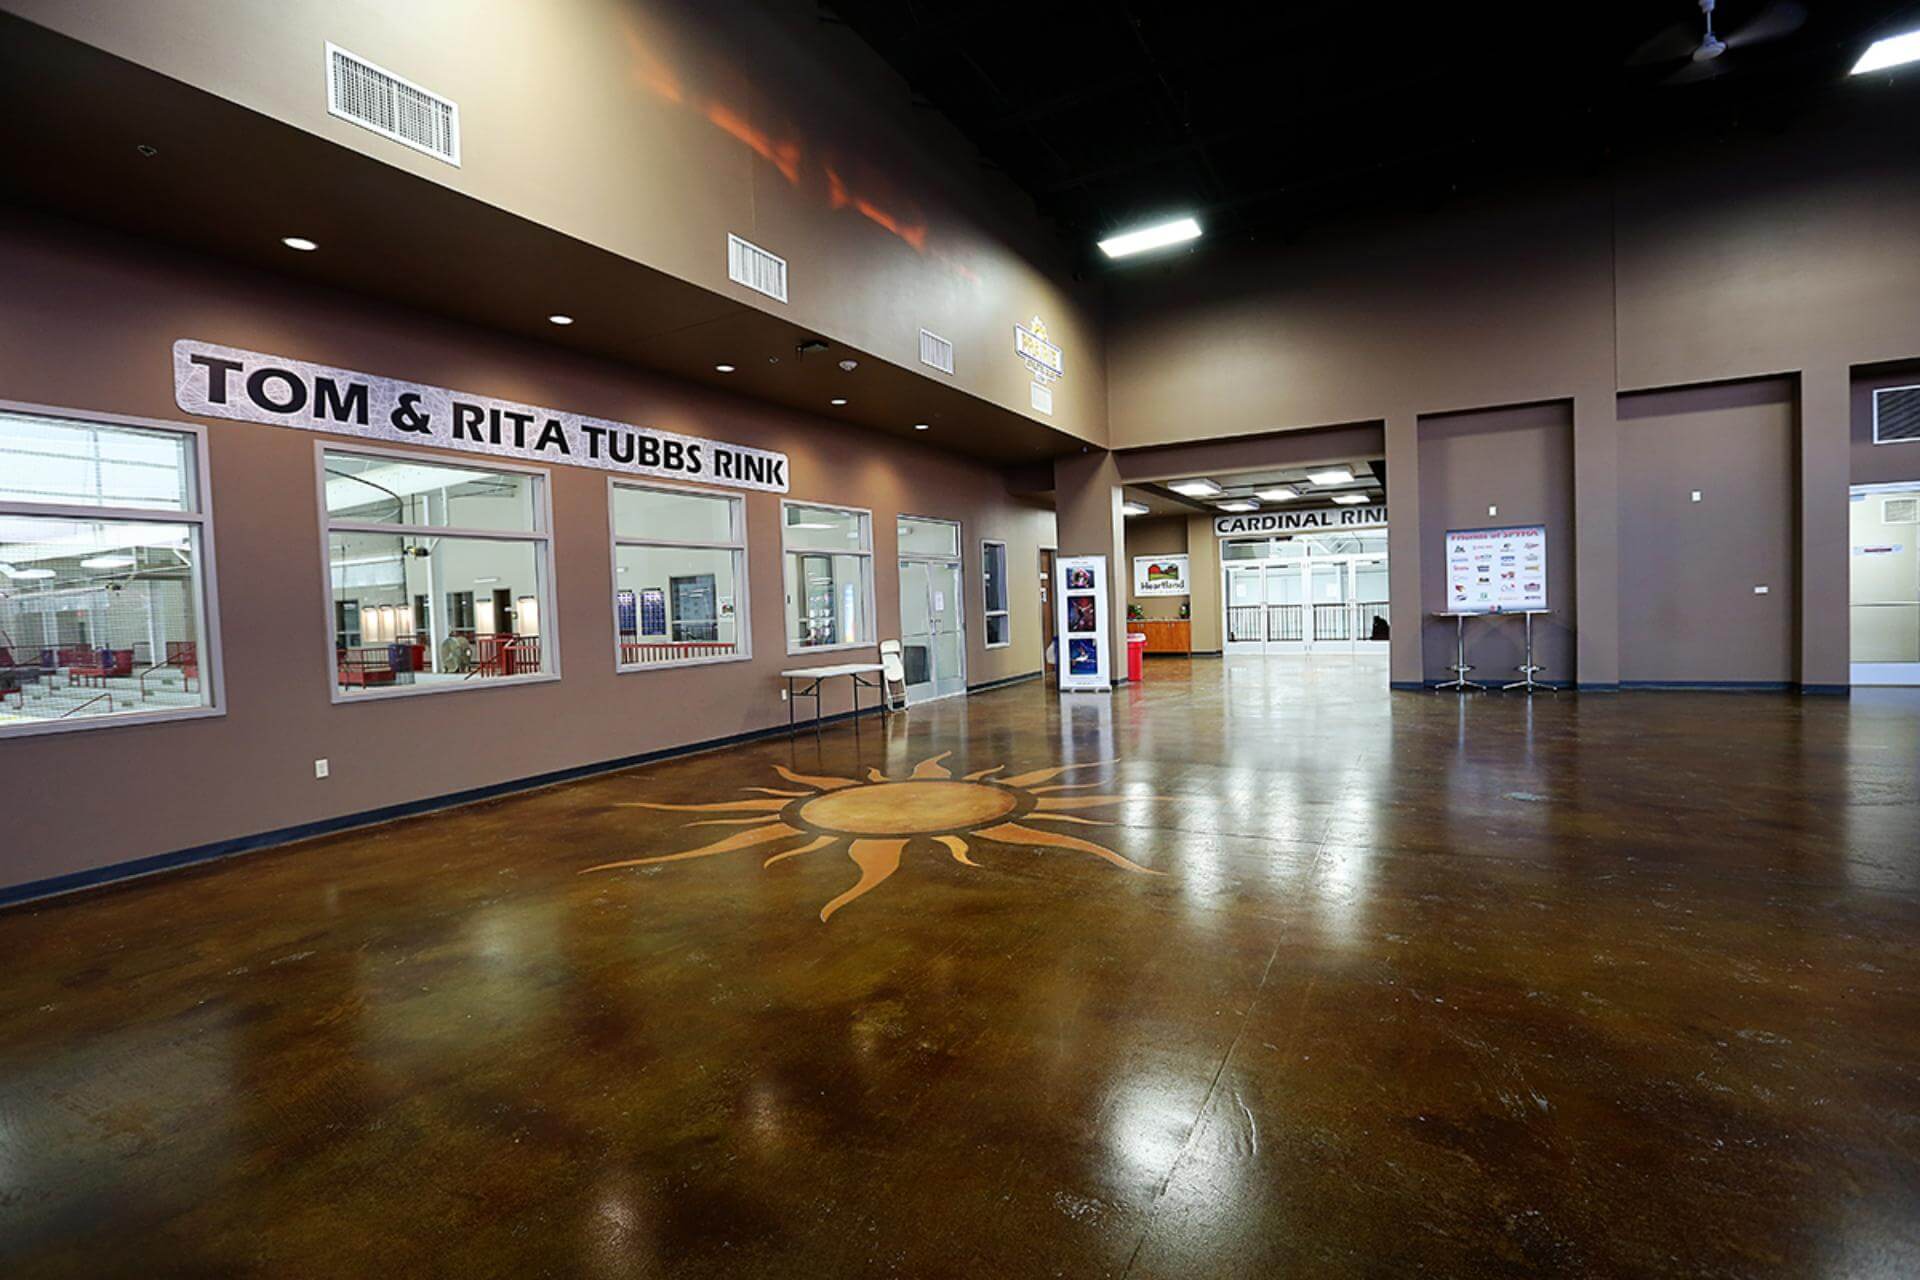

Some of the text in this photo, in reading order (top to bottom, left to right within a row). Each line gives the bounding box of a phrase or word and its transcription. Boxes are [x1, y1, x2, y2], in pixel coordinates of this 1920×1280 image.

[190, 353, 785, 487] TOM & RITA TUBBS RINK
[1217, 507, 1388, 533] CARDINAL RIN
